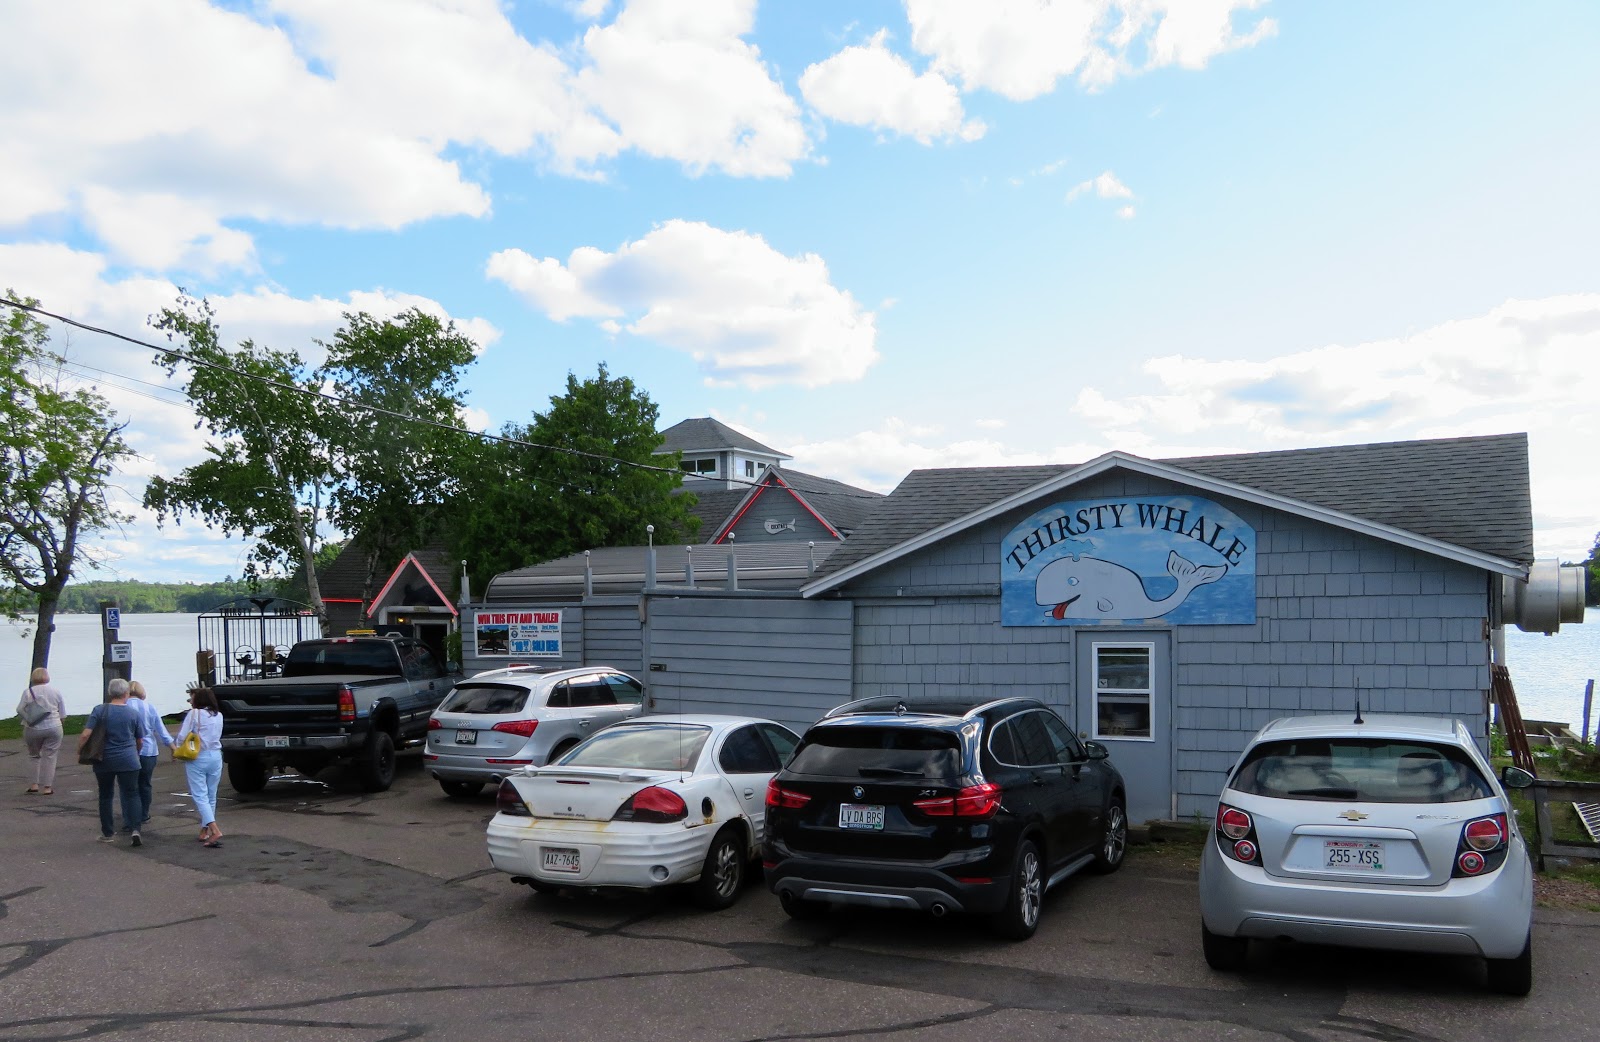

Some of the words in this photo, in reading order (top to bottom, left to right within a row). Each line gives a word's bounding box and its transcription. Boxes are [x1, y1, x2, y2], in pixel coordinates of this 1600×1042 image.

[1005, 503, 1128, 572] THIRSTY
[1136, 503, 1248, 567] WHALE
[220, 608, 252, 616] THIRSTY
[478, 614, 491, 624] WIN
[492, 614, 505, 624] THIS
[520, 613, 532, 623] AND
[534, 613, 559, 623] TRAILER
[841, 810, 852, 822] LV
[854, 811, 863, 823] DA
[867, 811, 882, 823] BRS
[546, 854, 580, 866] AAZ-7645
[1330, 849, 1379, 864] 255-XSS
